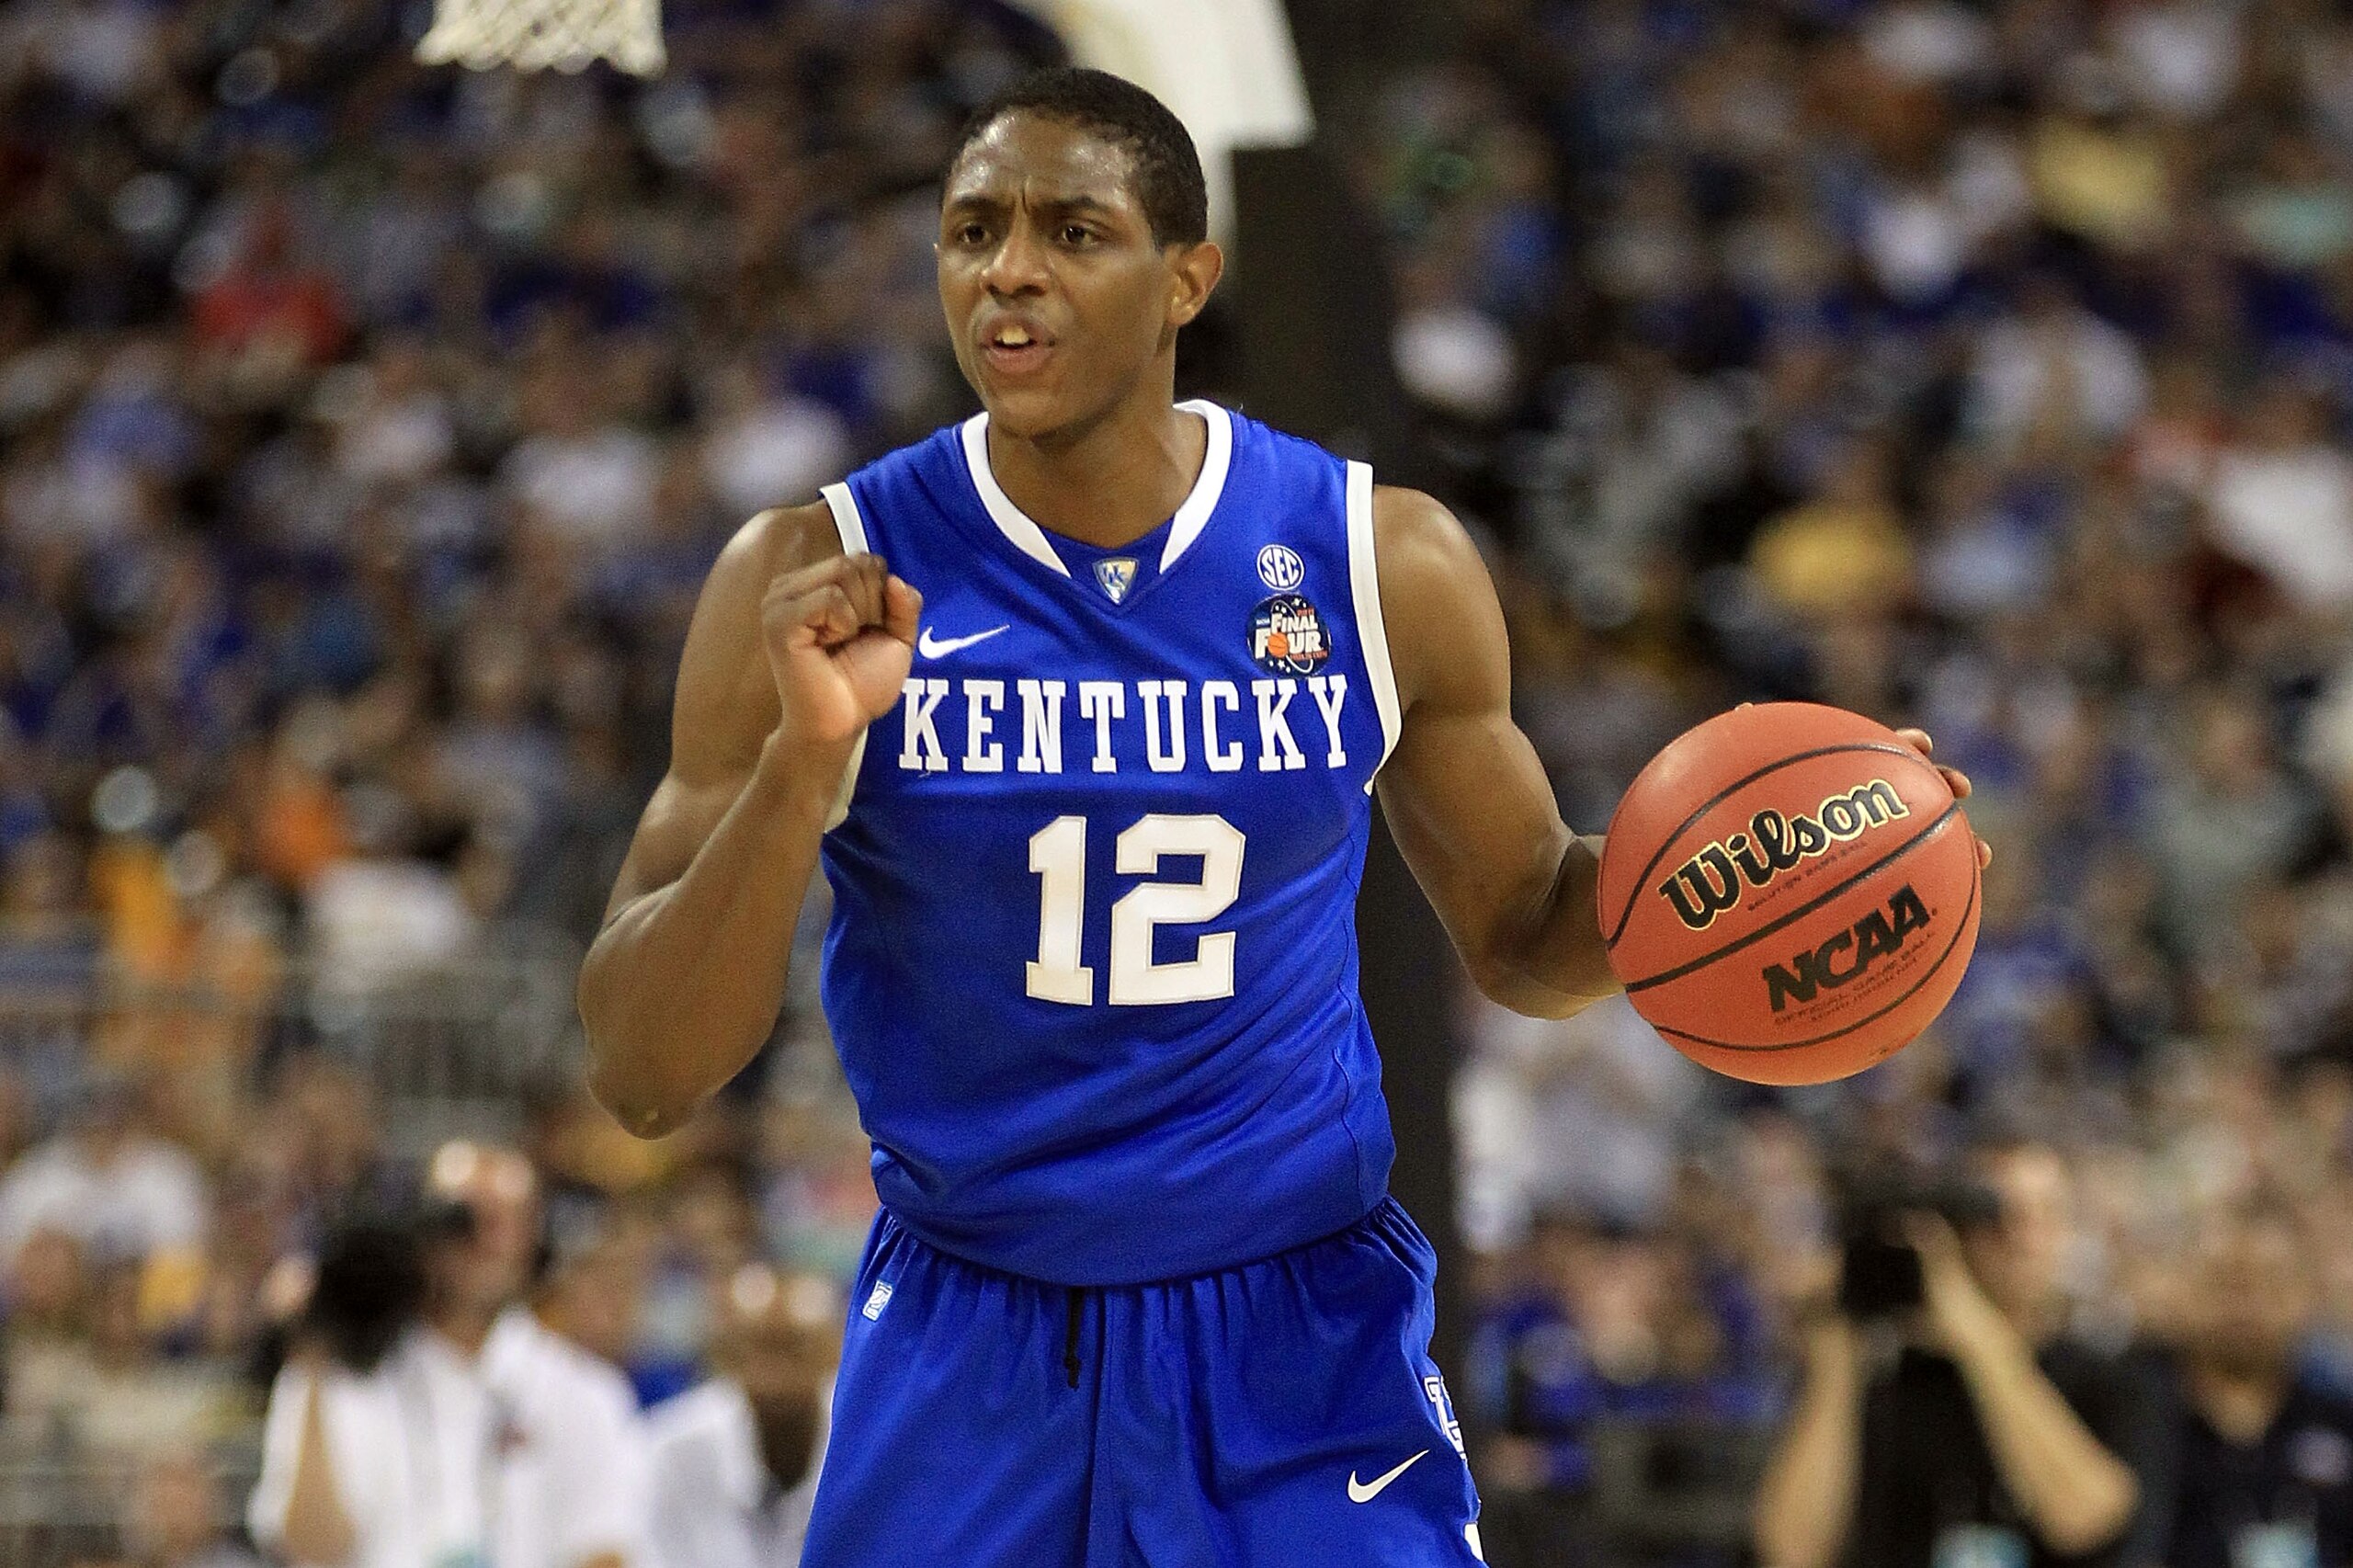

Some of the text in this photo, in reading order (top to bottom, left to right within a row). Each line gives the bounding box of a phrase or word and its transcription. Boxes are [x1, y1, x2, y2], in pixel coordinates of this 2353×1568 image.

[1260, 547, 1301, 587] SEC
[1271, 613, 1318, 634] FINAL
[899, 674, 1348, 773] KENTUCKY
[1026, 813, 1246, 1006] 12
[1657, 778, 1910, 930] Wilson
[1762, 883, 1931, 1012] NCAA
